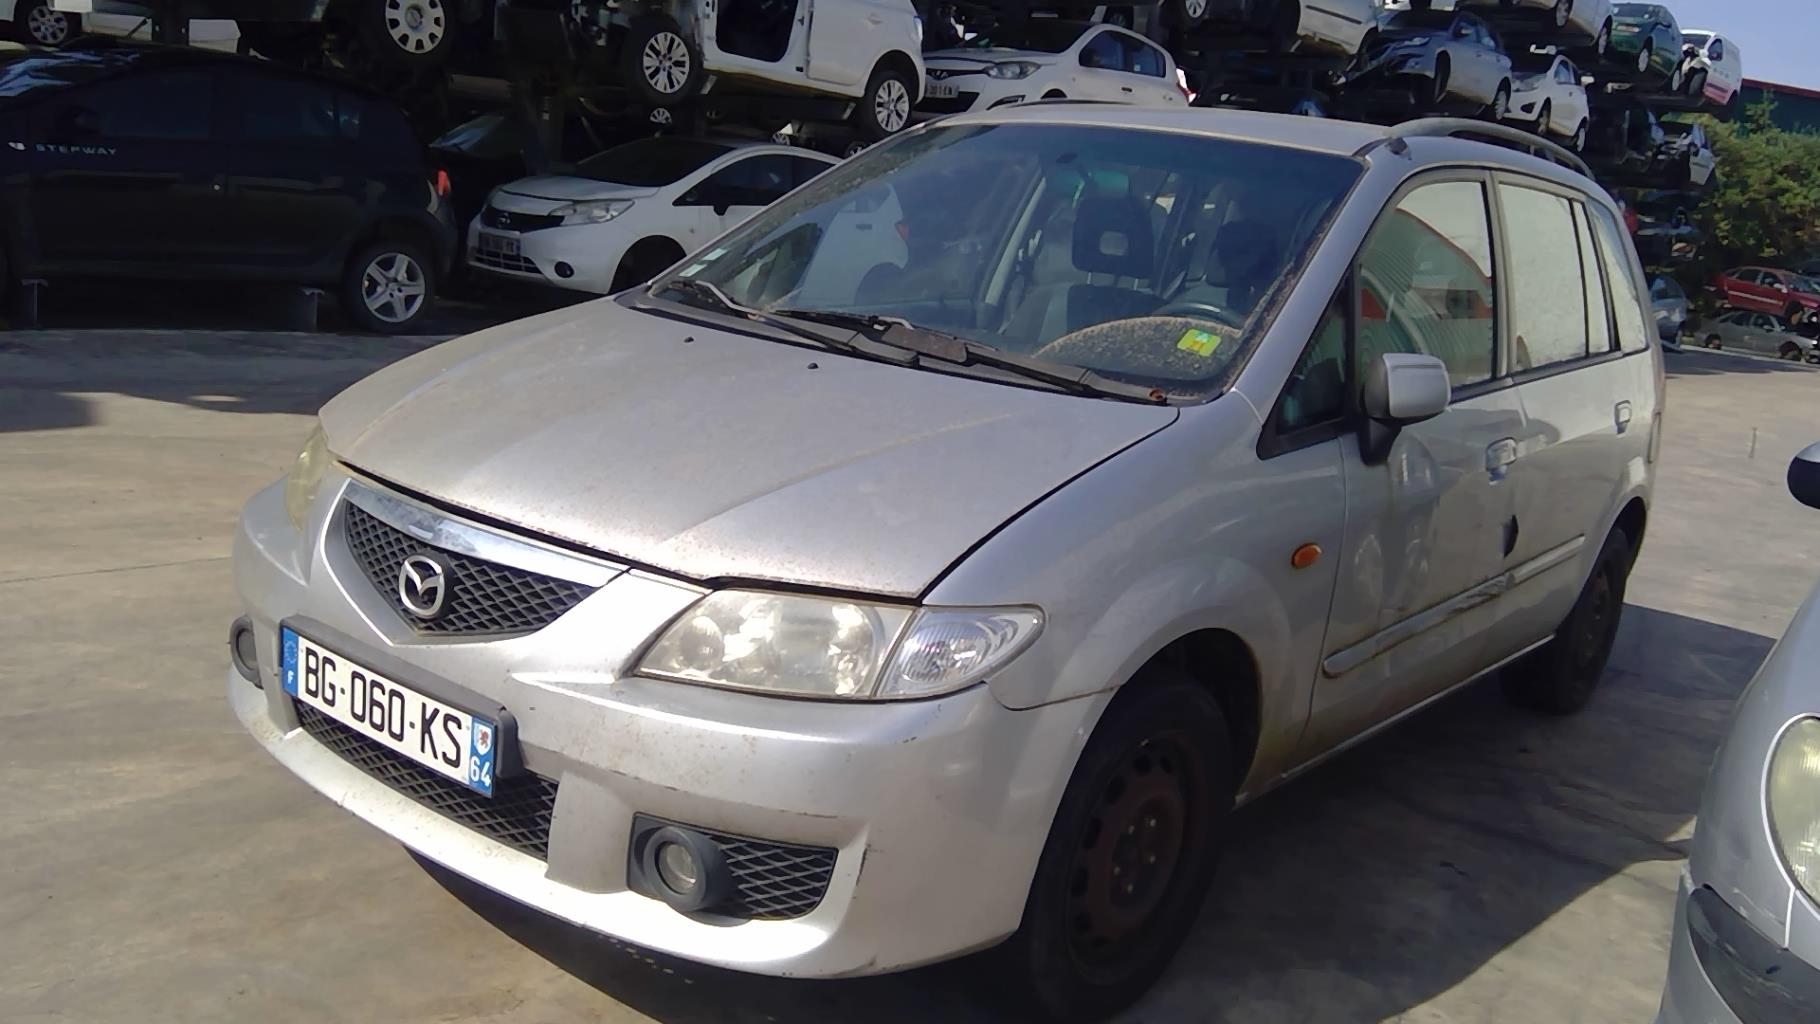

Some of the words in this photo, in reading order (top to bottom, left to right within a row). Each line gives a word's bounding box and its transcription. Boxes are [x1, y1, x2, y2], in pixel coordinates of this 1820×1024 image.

[35, 143, 117, 156] STEPWAY
[287, 670, 295, 685] F
[469, 755, 492, 788] 64
